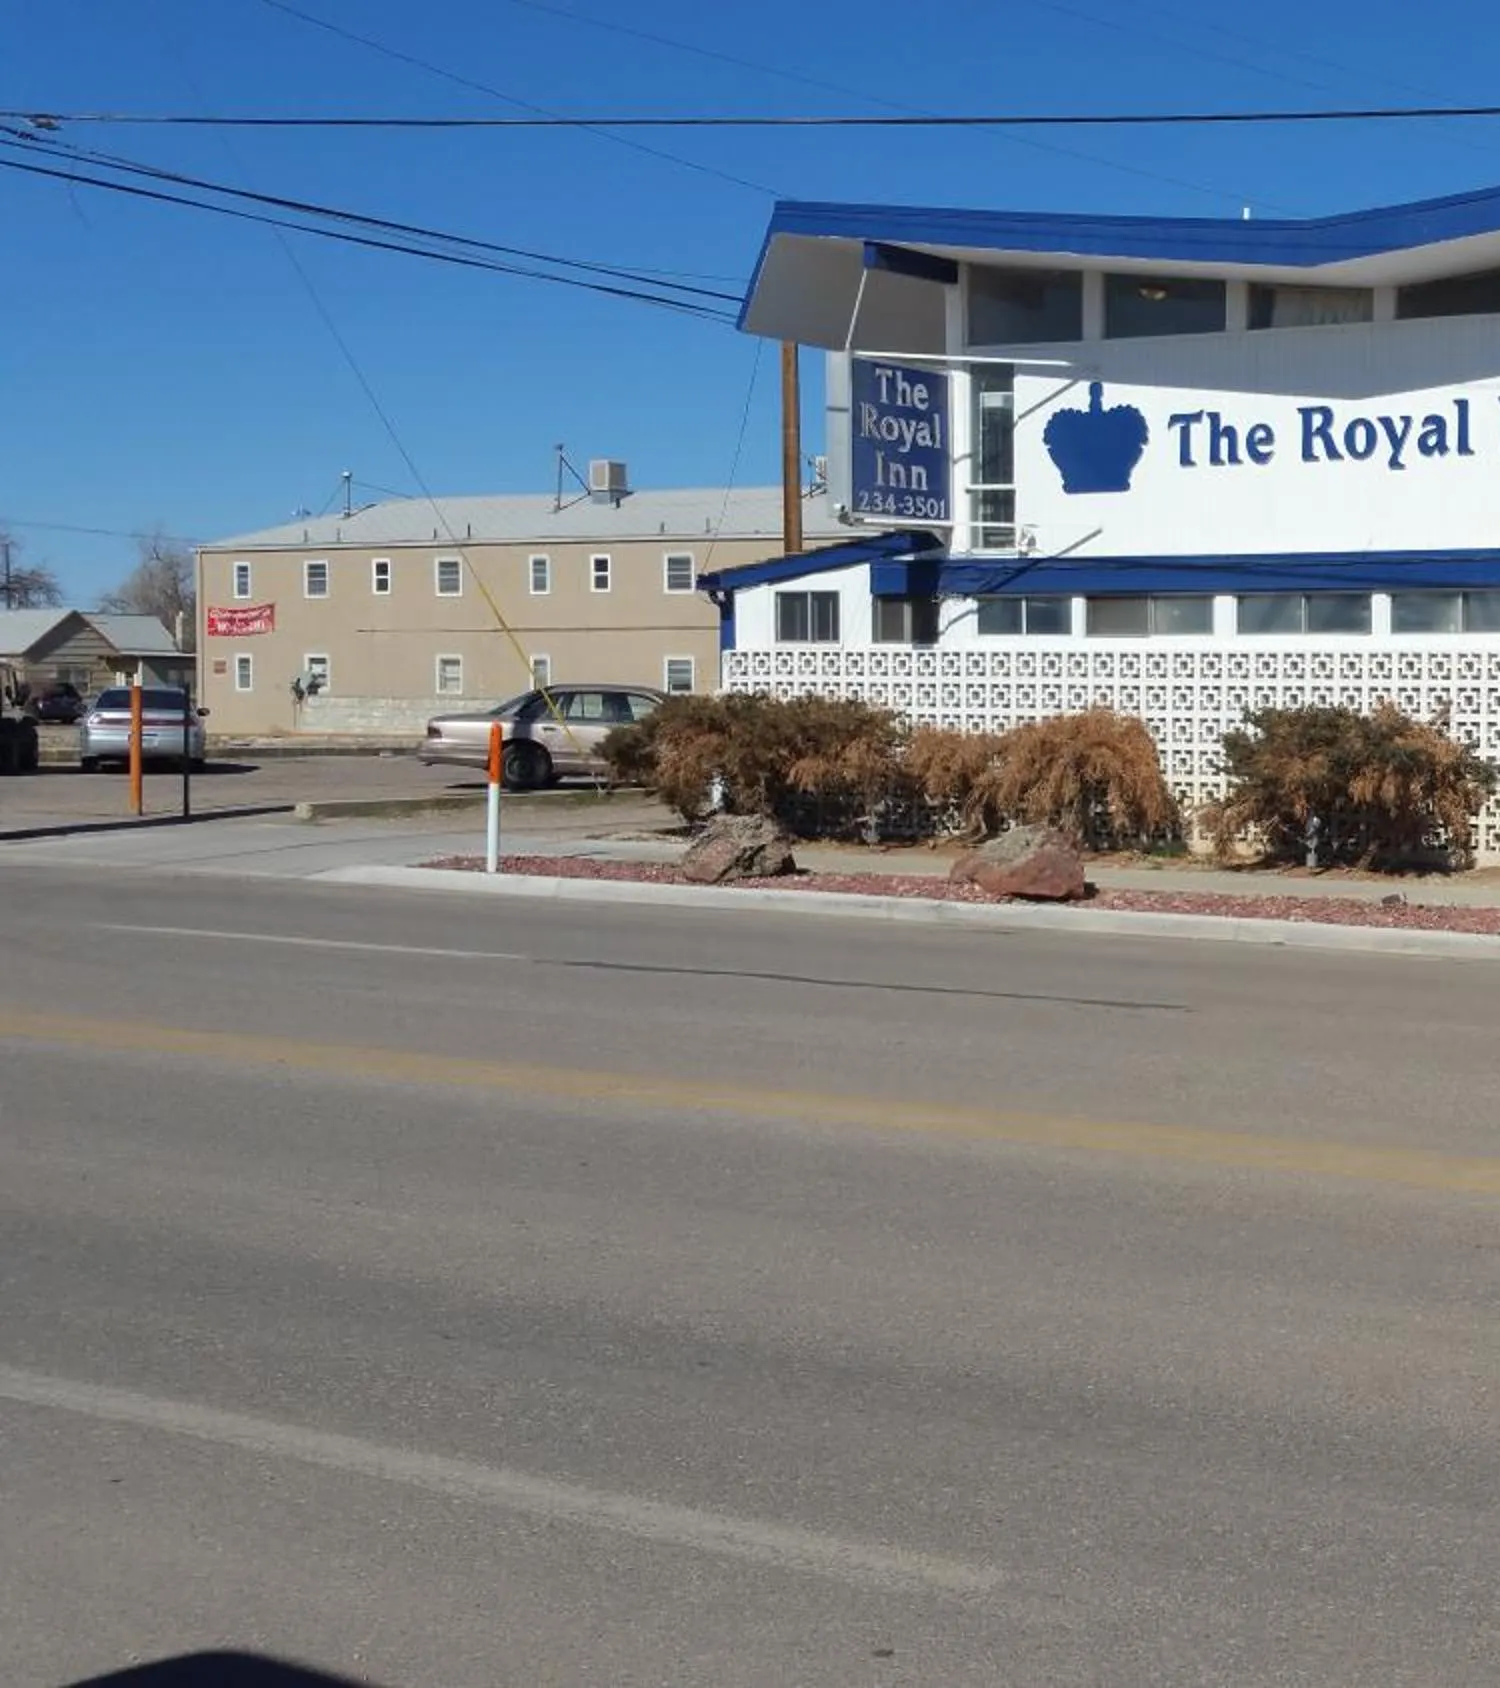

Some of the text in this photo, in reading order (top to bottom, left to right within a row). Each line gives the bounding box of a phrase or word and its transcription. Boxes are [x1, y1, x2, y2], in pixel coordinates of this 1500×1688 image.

[875, 367, 930, 411] The
[860, 401, 942, 453] Royal
[1168, 409, 1277, 468] The
[1297, 398, 1475, 470] Royal
[875, 451, 929, 491] Inn
[858, 491, 946, 519] 234-3501
